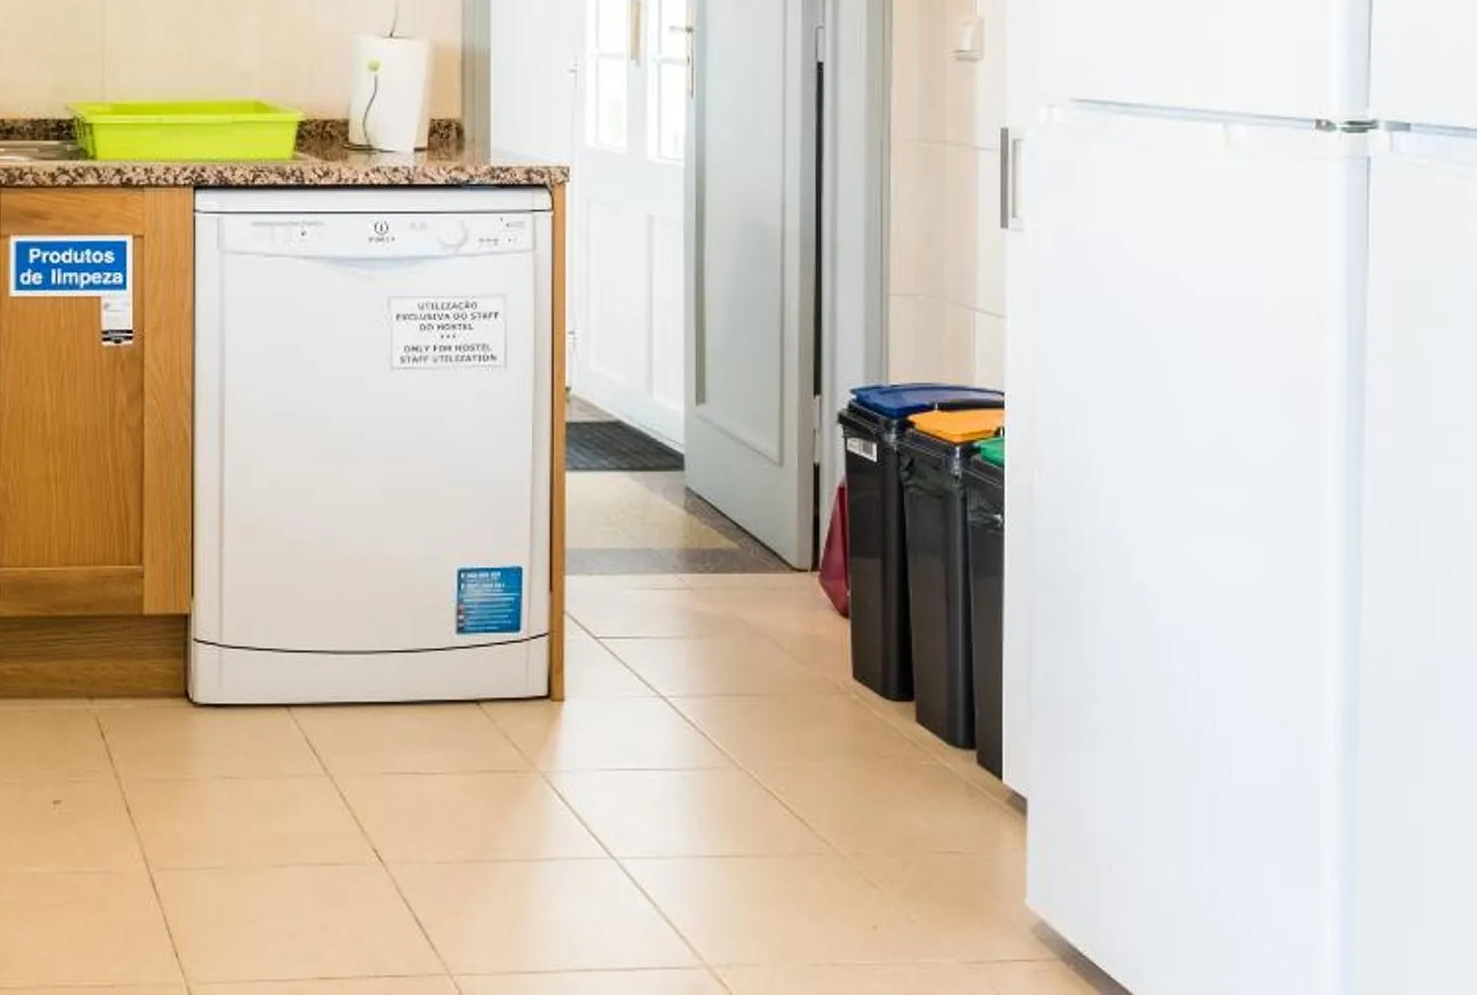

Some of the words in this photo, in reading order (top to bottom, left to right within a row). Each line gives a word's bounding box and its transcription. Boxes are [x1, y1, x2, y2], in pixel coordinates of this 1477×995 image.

[28, 248, 116, 265] Produtos
[19, 269, 43, 285] de
[51, 268, 124, 288] limpeza
[395, 312, 451, 321] EXCLUSIVA
[452, 312, 468, 321] DO
[470, 311, 500, 320] STAFF
[419, 322, 435, 332] DO
[437, 322, 475, 331] HOSTEL
[403, 344, 431, 353] ONLY
[433, 344, 452, 353] FOR
[454, 343, 492, 353] HOSTEL
[399, 355, 430, 365] STAFF
[431, 354, 498, 363] UTILIZATION
